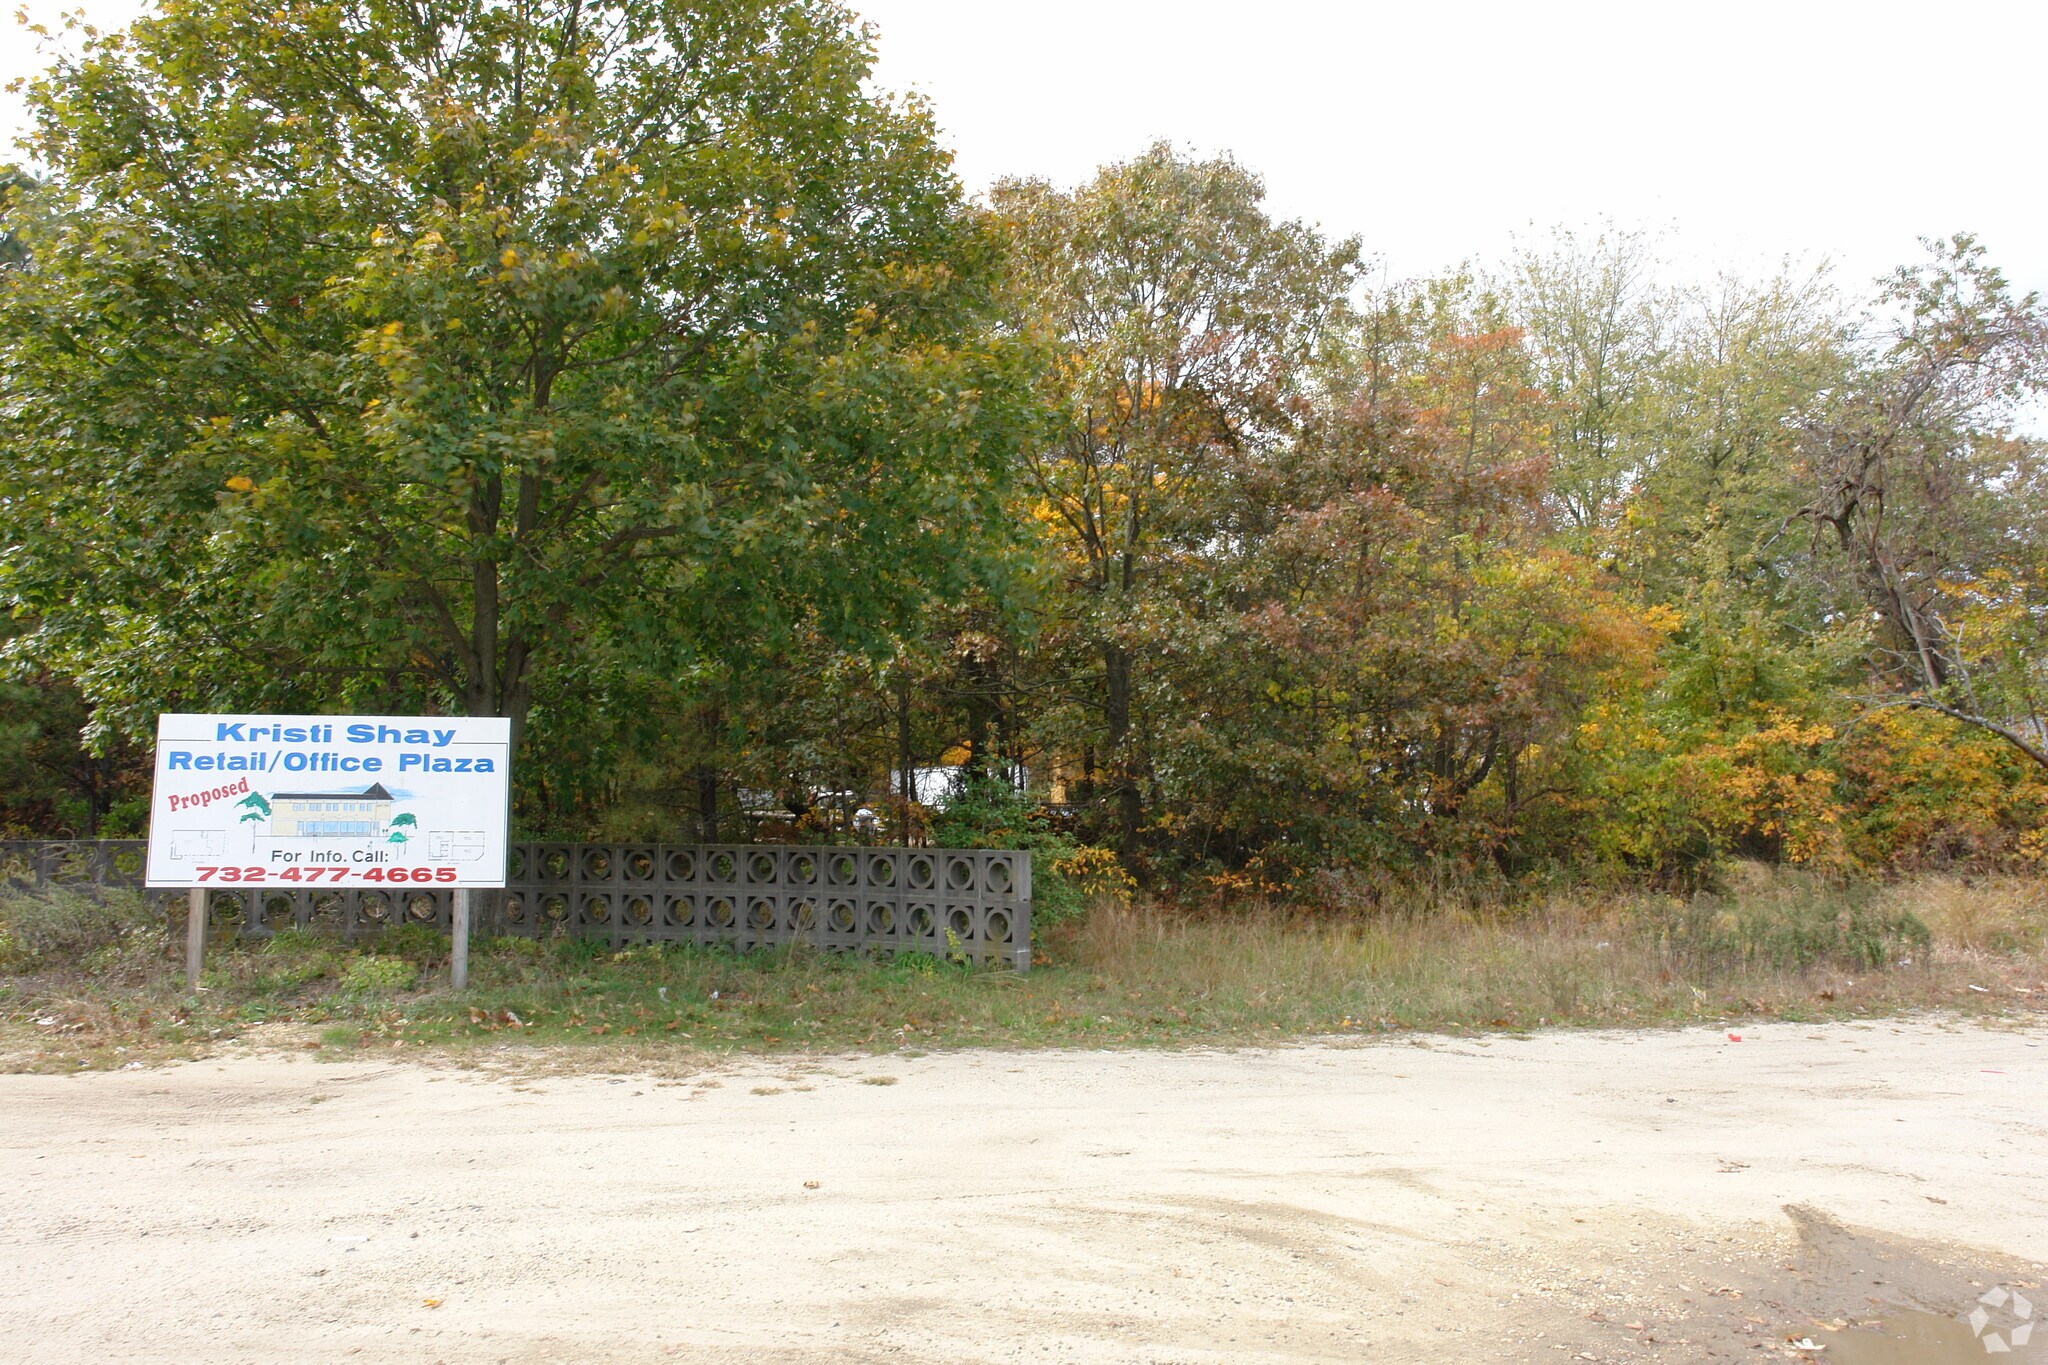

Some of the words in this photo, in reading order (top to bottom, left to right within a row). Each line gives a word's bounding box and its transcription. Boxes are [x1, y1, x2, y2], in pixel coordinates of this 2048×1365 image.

[216, 722, 332, 743] Kristi
[346, 724, 457, 747] Shay
[168, 750, 383, 773] Retail/Office
[399, 753, 495, 773] Plaza
[168, 777, 250, 812] Proposed
[271, 850, 302, 862] For
[310, 850, 347, 863] Info.
[352, 850, 389, 863] Call:
[195, 866, 457, 883] 732-477-4665
